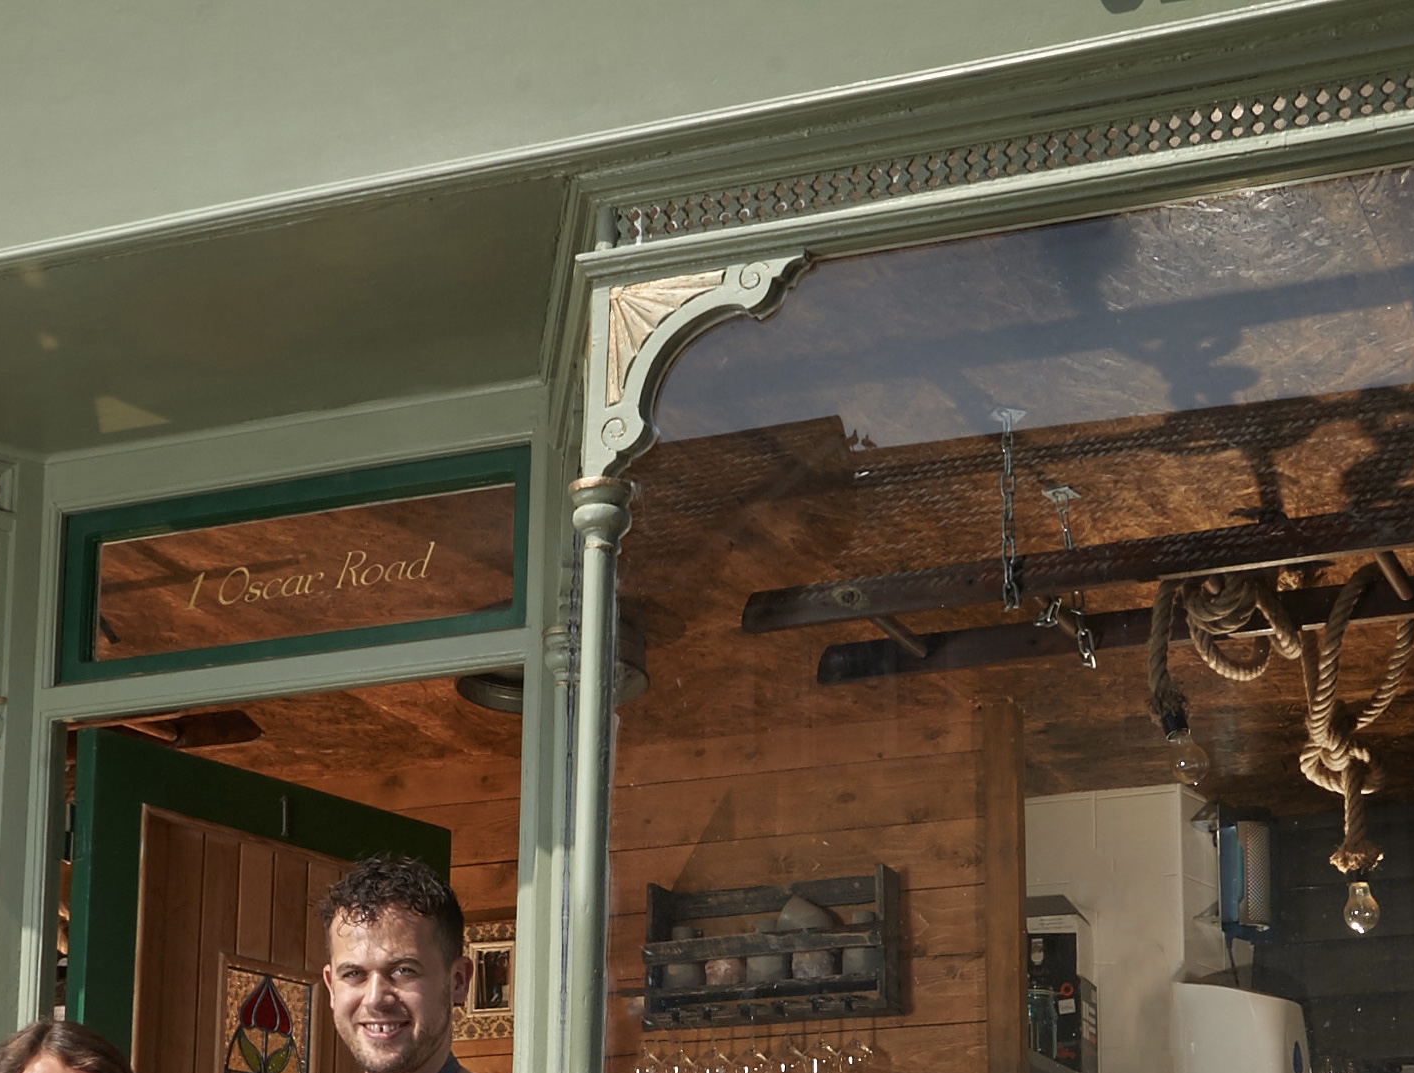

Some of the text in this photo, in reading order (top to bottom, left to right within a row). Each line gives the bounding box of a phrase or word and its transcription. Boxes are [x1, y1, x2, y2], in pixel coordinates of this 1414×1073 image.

[187, 541, 436, 610] 1 Oscar Road
